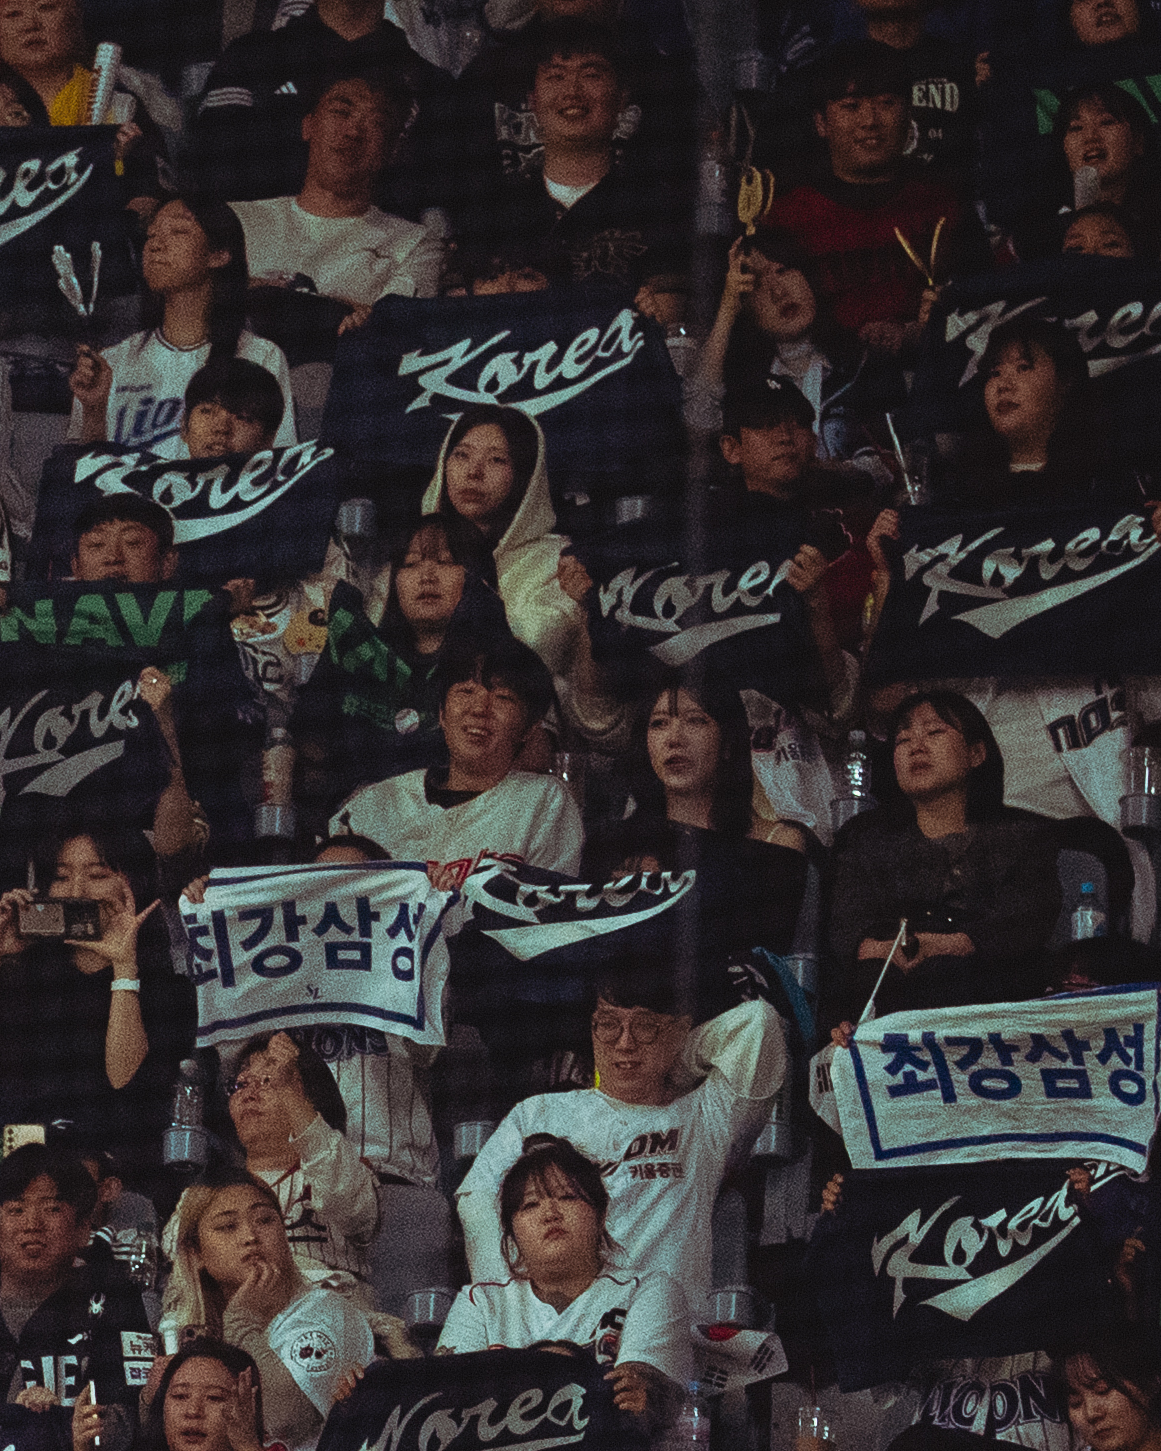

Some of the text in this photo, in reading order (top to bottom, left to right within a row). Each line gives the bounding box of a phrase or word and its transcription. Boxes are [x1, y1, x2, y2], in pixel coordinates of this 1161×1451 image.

[398, 309, 645, 413] Korea
[74, 438, 335, 530] Korea
[903, 513, 1161, 627] Korea
[880, 1022, 1147, 1106] 최강삼성
[870, 1187, 1080, 1319] Korea
